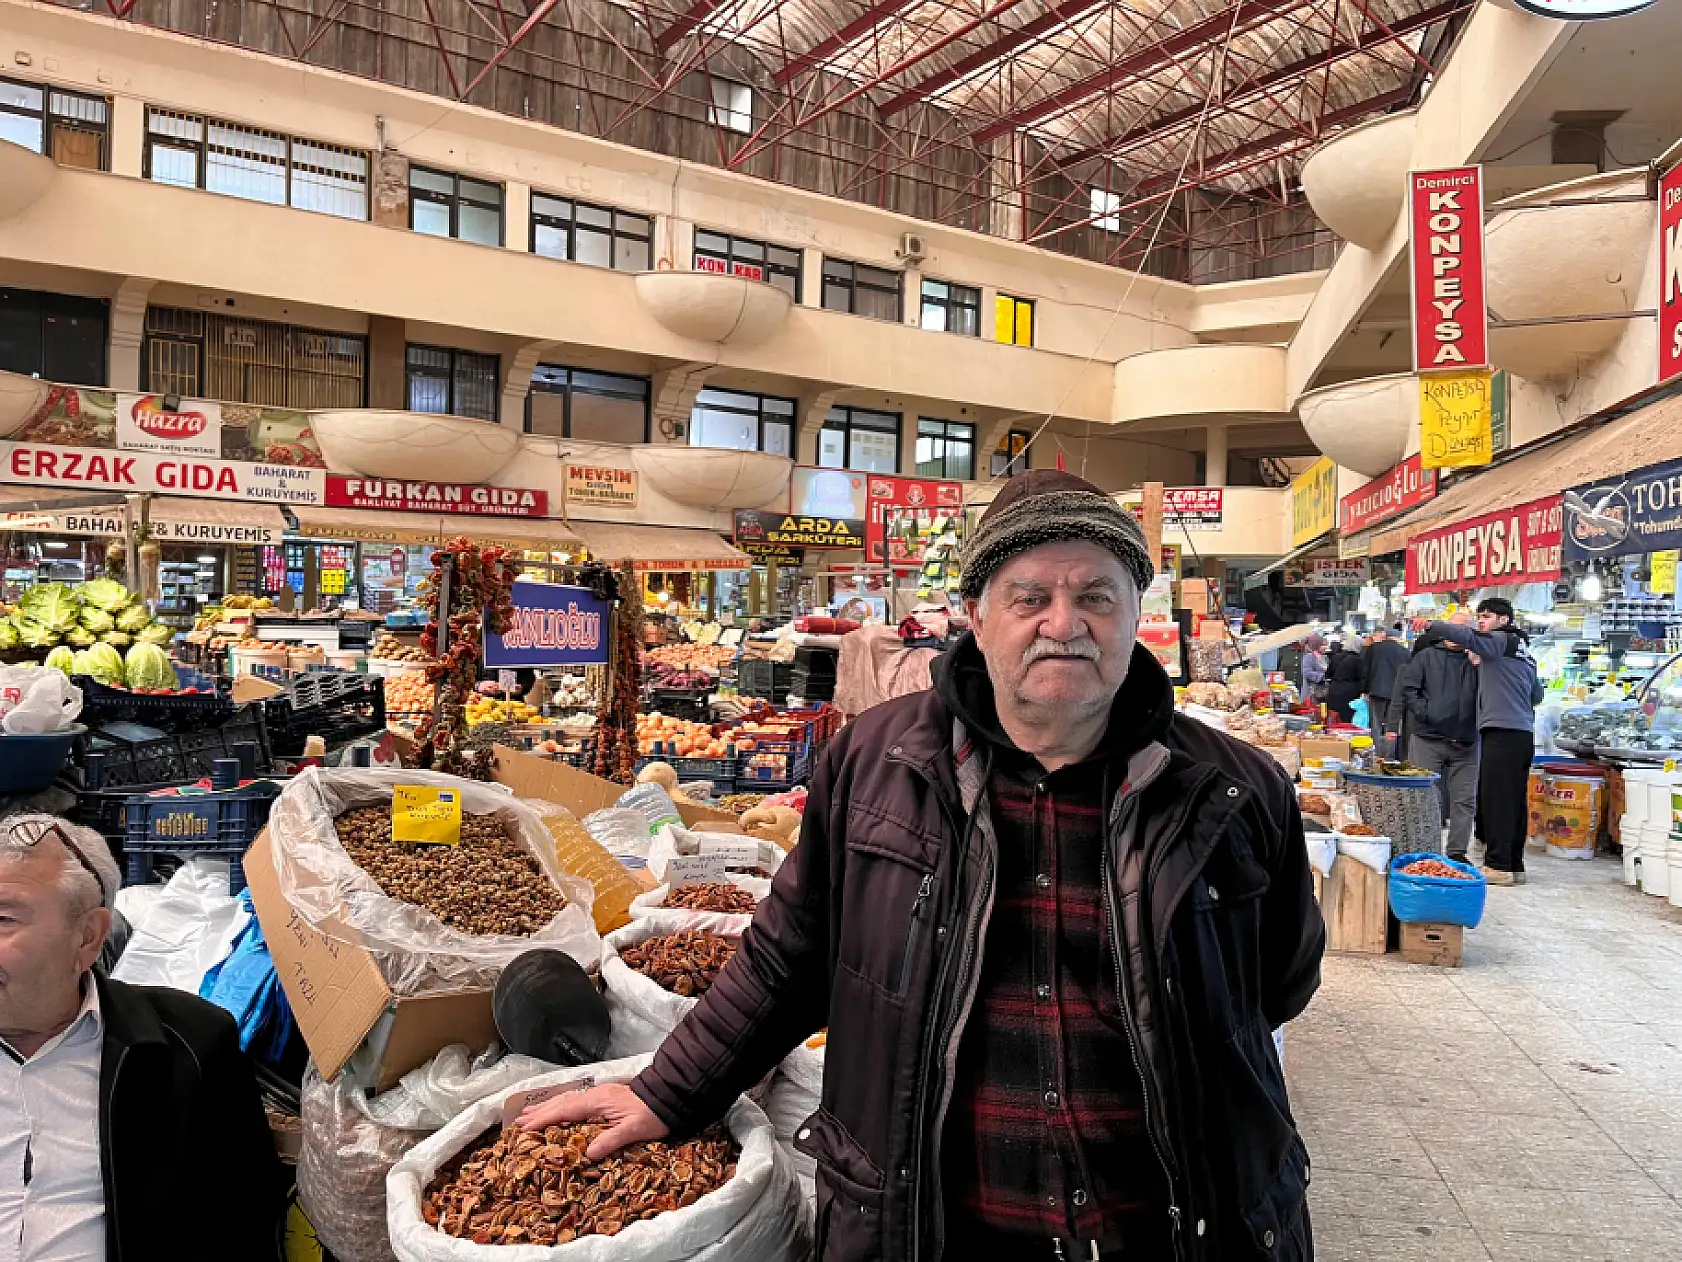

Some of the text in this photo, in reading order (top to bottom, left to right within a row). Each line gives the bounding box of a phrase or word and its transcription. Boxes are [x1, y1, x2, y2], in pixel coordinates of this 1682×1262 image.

[1416, 174, 1475, 189] Demirci
[1428, 189, 1466, 365] KONPEYSA
[137, 409, 201, 432] Hazra
[11, 449, 239, 493] ERZAK GIDA
[253, 466, 312, 480] BAHARAT
[346, 479, 536, 507] FURKAN GIDA
[175, 523, 272, 543] KURUYEMİŞ
[779, 516, 850, 534] ARDA
[1418, 516, 1523, 584] KONPEYSA
